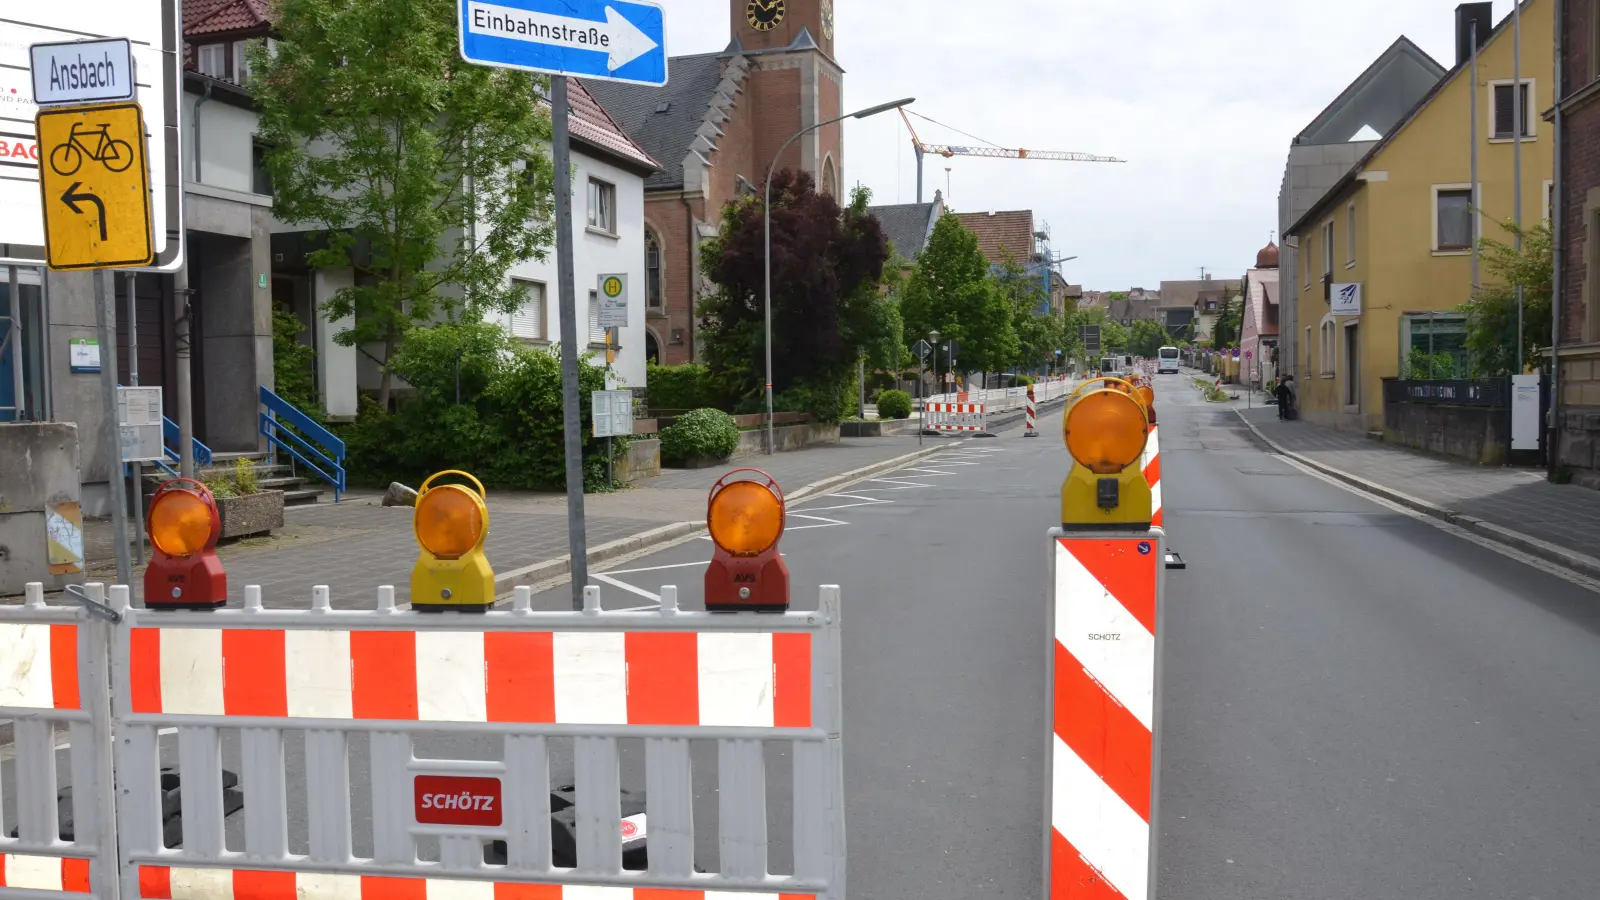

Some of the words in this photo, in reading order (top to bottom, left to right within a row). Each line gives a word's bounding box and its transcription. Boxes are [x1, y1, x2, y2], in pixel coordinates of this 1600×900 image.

[474, 9, 609, 47] Einbahnstraße
[50, 51, 115, 91] Ansbach
[608, 280, 617, 294] H
[734, 573, 756, 583] AVS
[421, 791, 494, 811] SCHÖTZ
